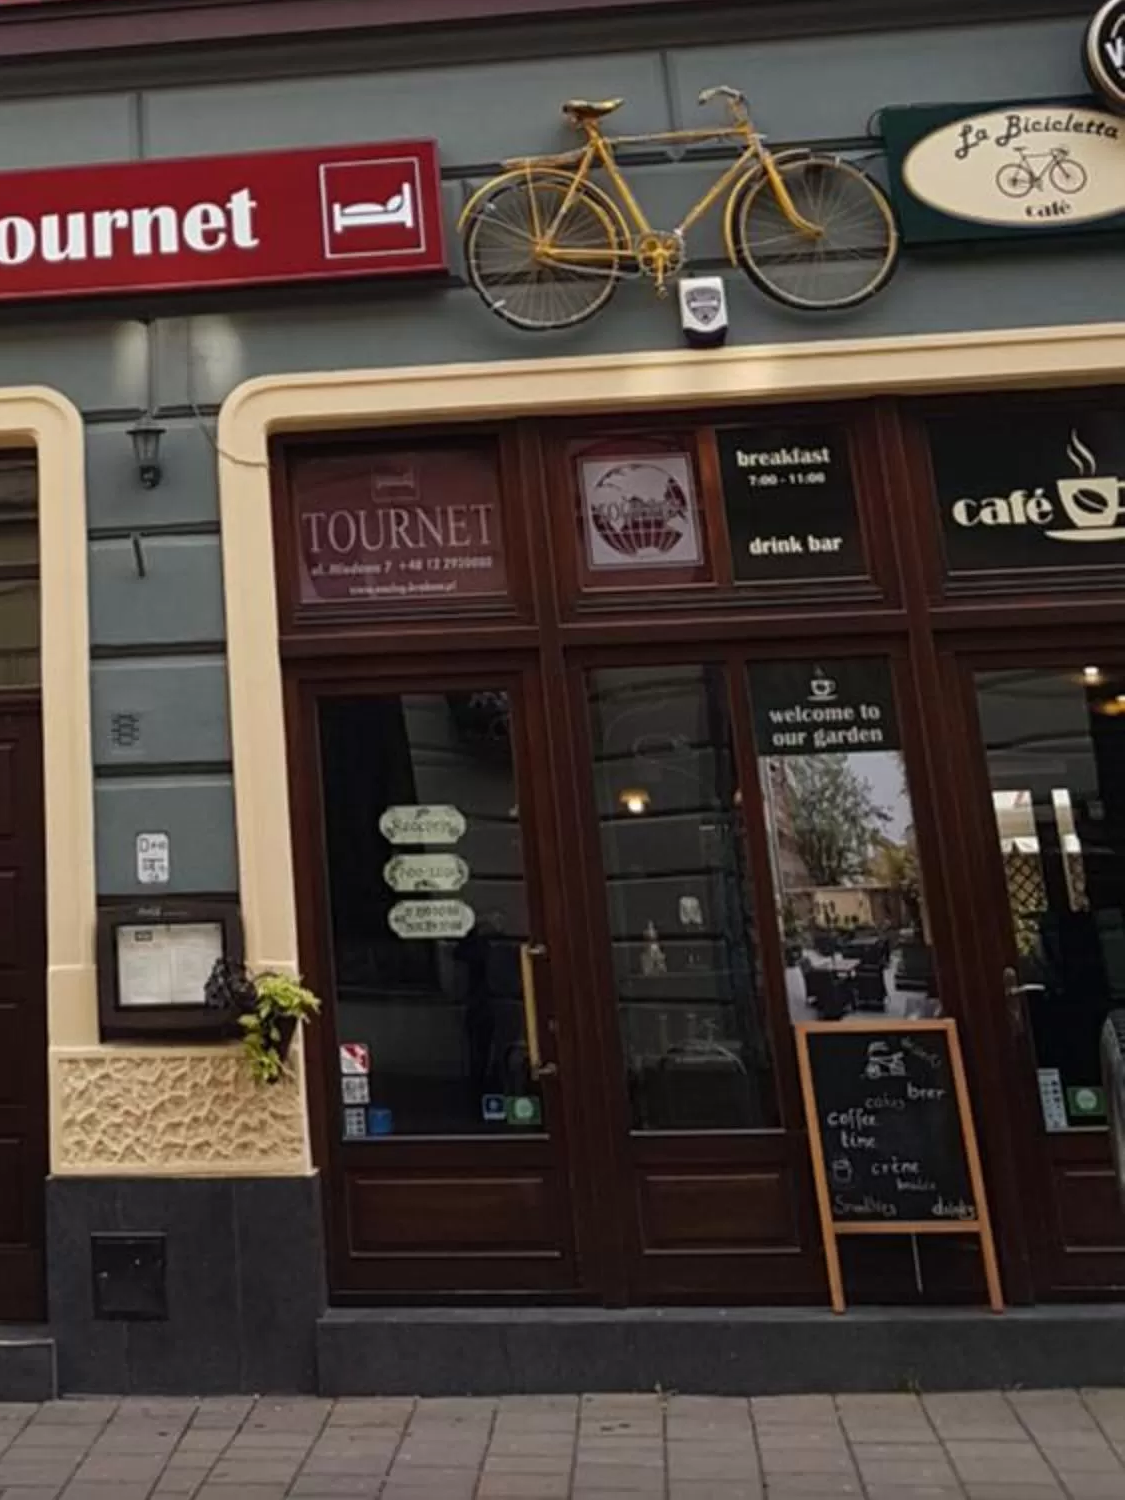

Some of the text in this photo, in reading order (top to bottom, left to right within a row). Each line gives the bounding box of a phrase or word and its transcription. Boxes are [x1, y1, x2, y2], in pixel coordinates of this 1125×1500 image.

[955, 113, 1119, 160] La Bicicletta
[736, 447, 830, 467] breakfast
[748, 474, 777, 486] 7:00
[789, 472, 825, 485] 11:00
[952, 488, 1054, 527] café
[302, 503, 494, 554] TOURNET
[749, 535, 843, 555] drink bar
[768, 704, 881, 724] welcome to
[772, 725, 884, 749] our garden
[827, 1108, 876, 1130] coffee
